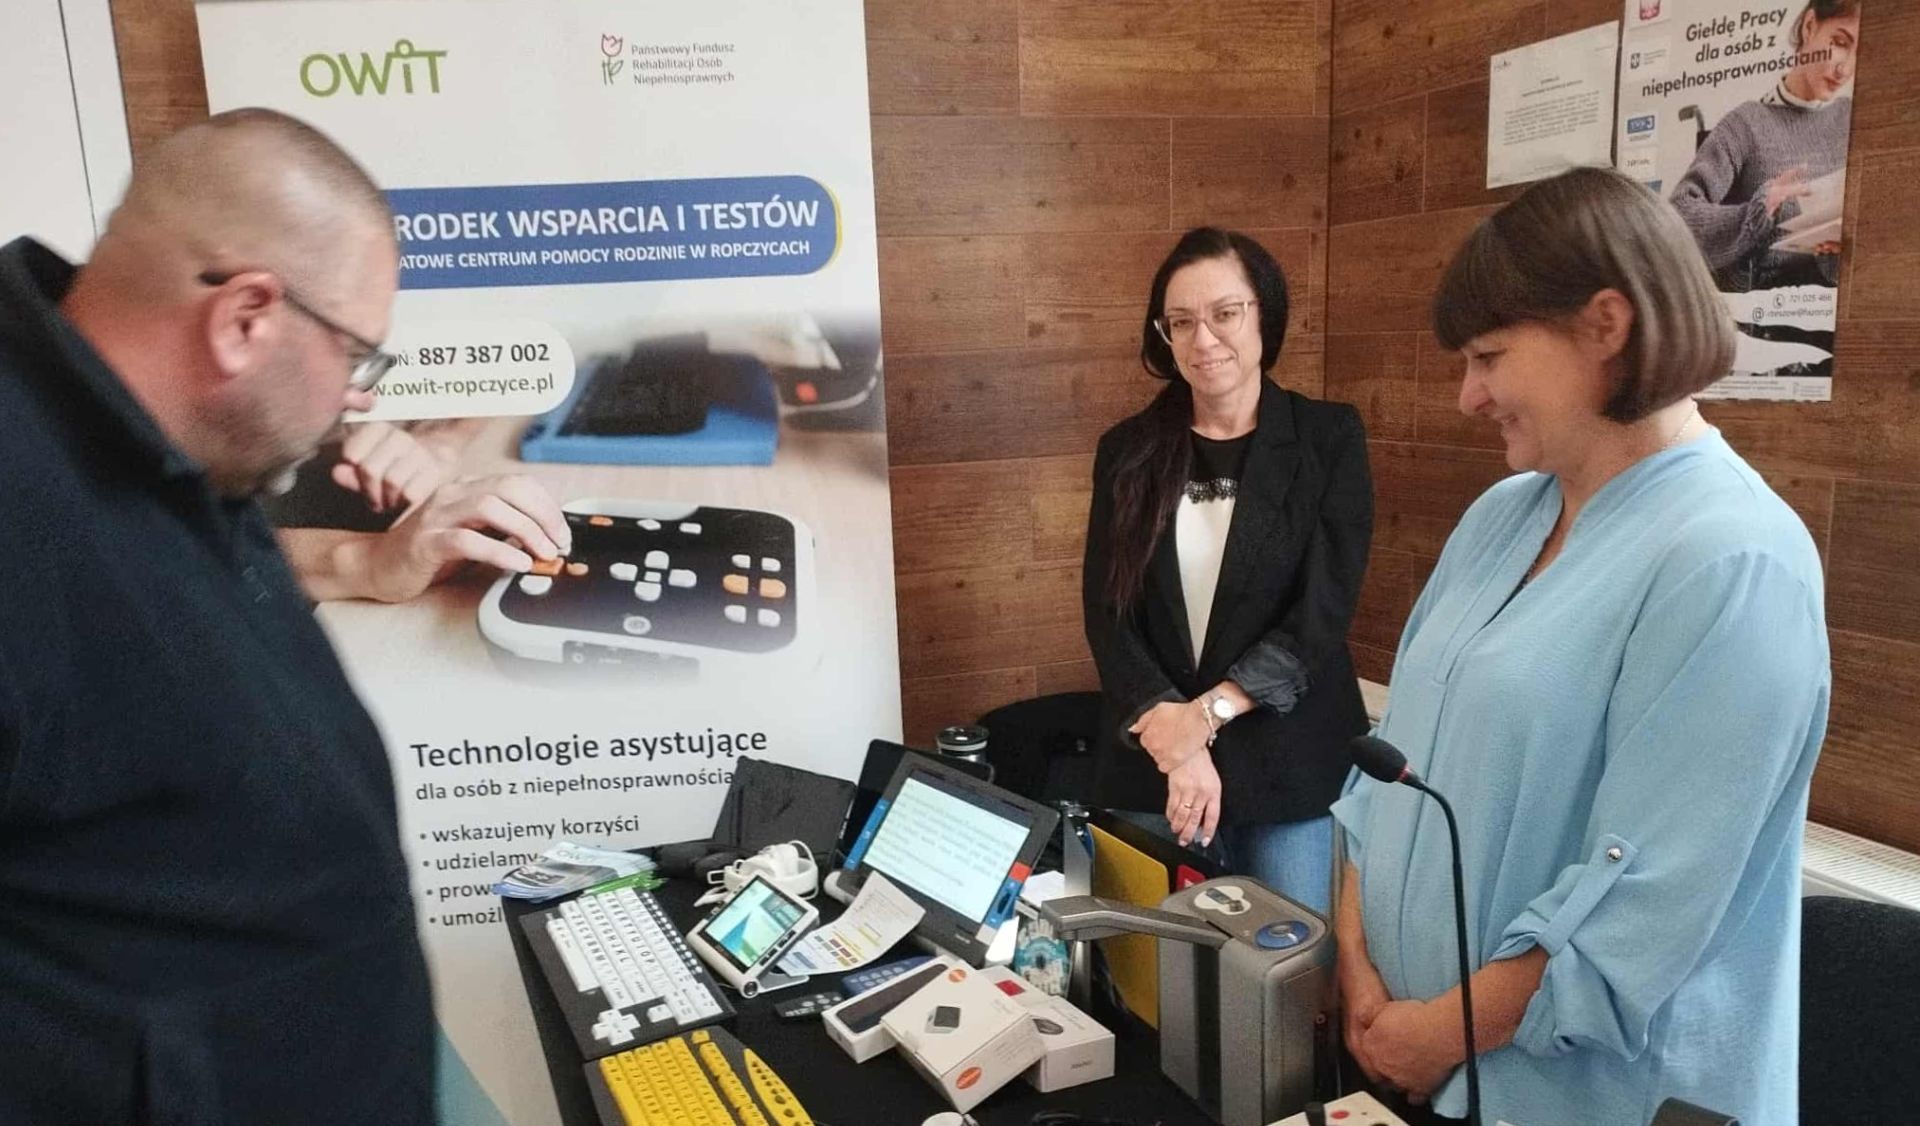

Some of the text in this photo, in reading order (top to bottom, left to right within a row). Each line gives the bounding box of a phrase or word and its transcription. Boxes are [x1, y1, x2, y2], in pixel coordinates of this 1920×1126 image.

[1686, 7, 1788, 41] Giełdę Pracy
[631, 43, 735, 56] Państwowy Fundusz
[1695, 32, 1777, 63] dla osób z
[632, 58, 723, 70] Rehabilitacji Osób
[1641, 43, 1832, 97] niepełnosprawnościami
[634, 72, 735, 86] Niepełnosprawnych
[393, 194, 819, 241] RODEK WSPARCIA I TESTÓW
[399, 240, 810, 270] ATOWE CENTRUM POMOCY RODZINIE W ROPCZYCACH
[419, 346, 457, 366] 887
[465, 345, 503, 364] 387
[511, 343, 550, 362] 002
[374, 373, 554, 398] w.owit-ropczyce.pl
[410, 728, 768, 768] Technologie asystujące
[416, 768, 734, 800] dla osób z niepełnosprawnościa
[432, 815, 640, 843] wskazujemy korzyści
[439, 884, 491, 902] prow
[442, 906, 502, 926] umożl
